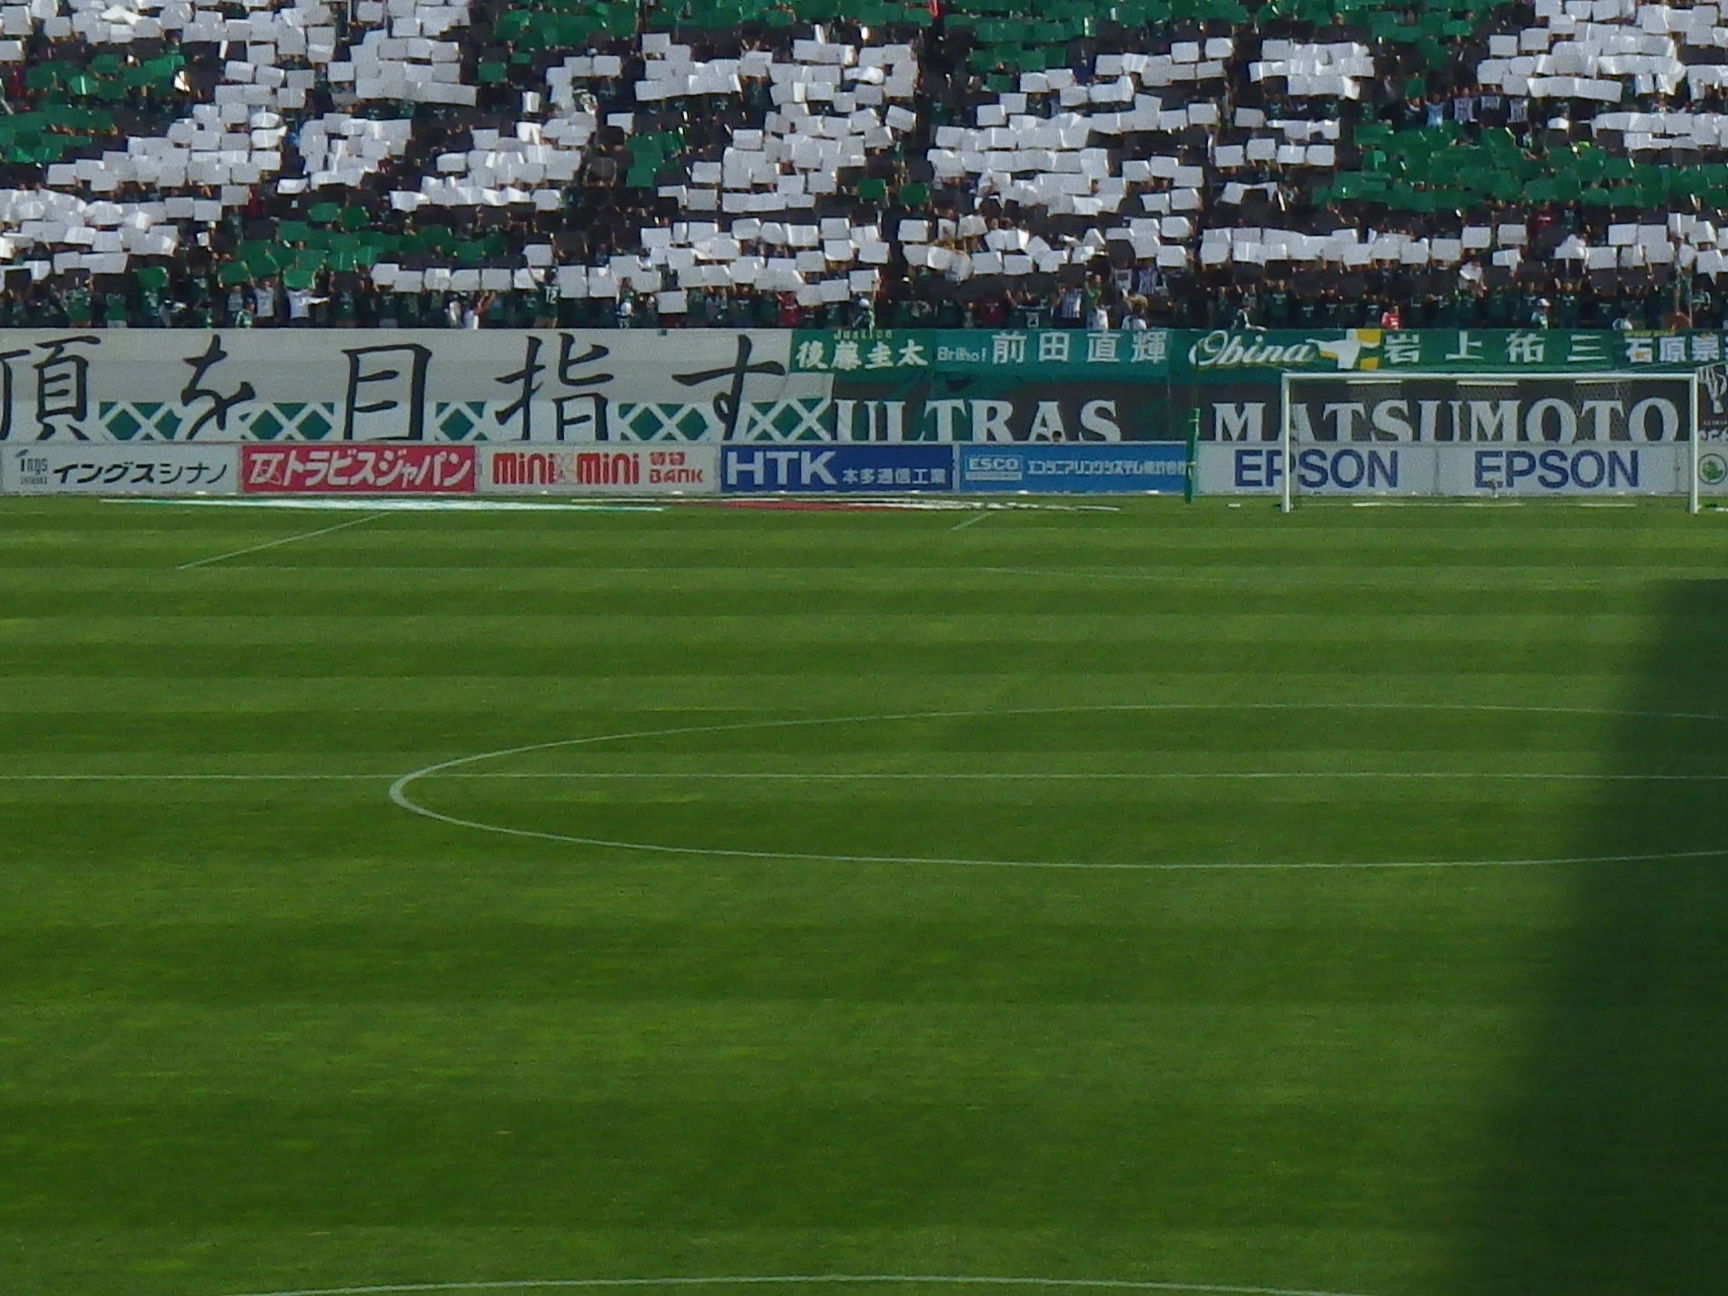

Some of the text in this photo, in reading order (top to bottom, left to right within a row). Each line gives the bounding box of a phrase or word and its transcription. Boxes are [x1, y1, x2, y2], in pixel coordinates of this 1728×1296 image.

[796, 338, 928, 371] 後藤圭太
[993, 331, 1169, 364] 前田直輝
[1384, 330, 1607, 364] 岩上祐三
[834, 397, 1679, 443] ULTRAS MATSUMOTO
[54, 461, 227, 484] イングスシナノ
[283, 449, 471, 488] トラビスジャパン
[576, 452, 640, 485] mini
[650, 469, 703, 484] BANK
[727, 451, 838, 485] HTK
[969, 458, 1019, 470] ESCO
[1235, 449, 1398, 488] EPSON
[1474, 449, 1639, 489] EPSON
